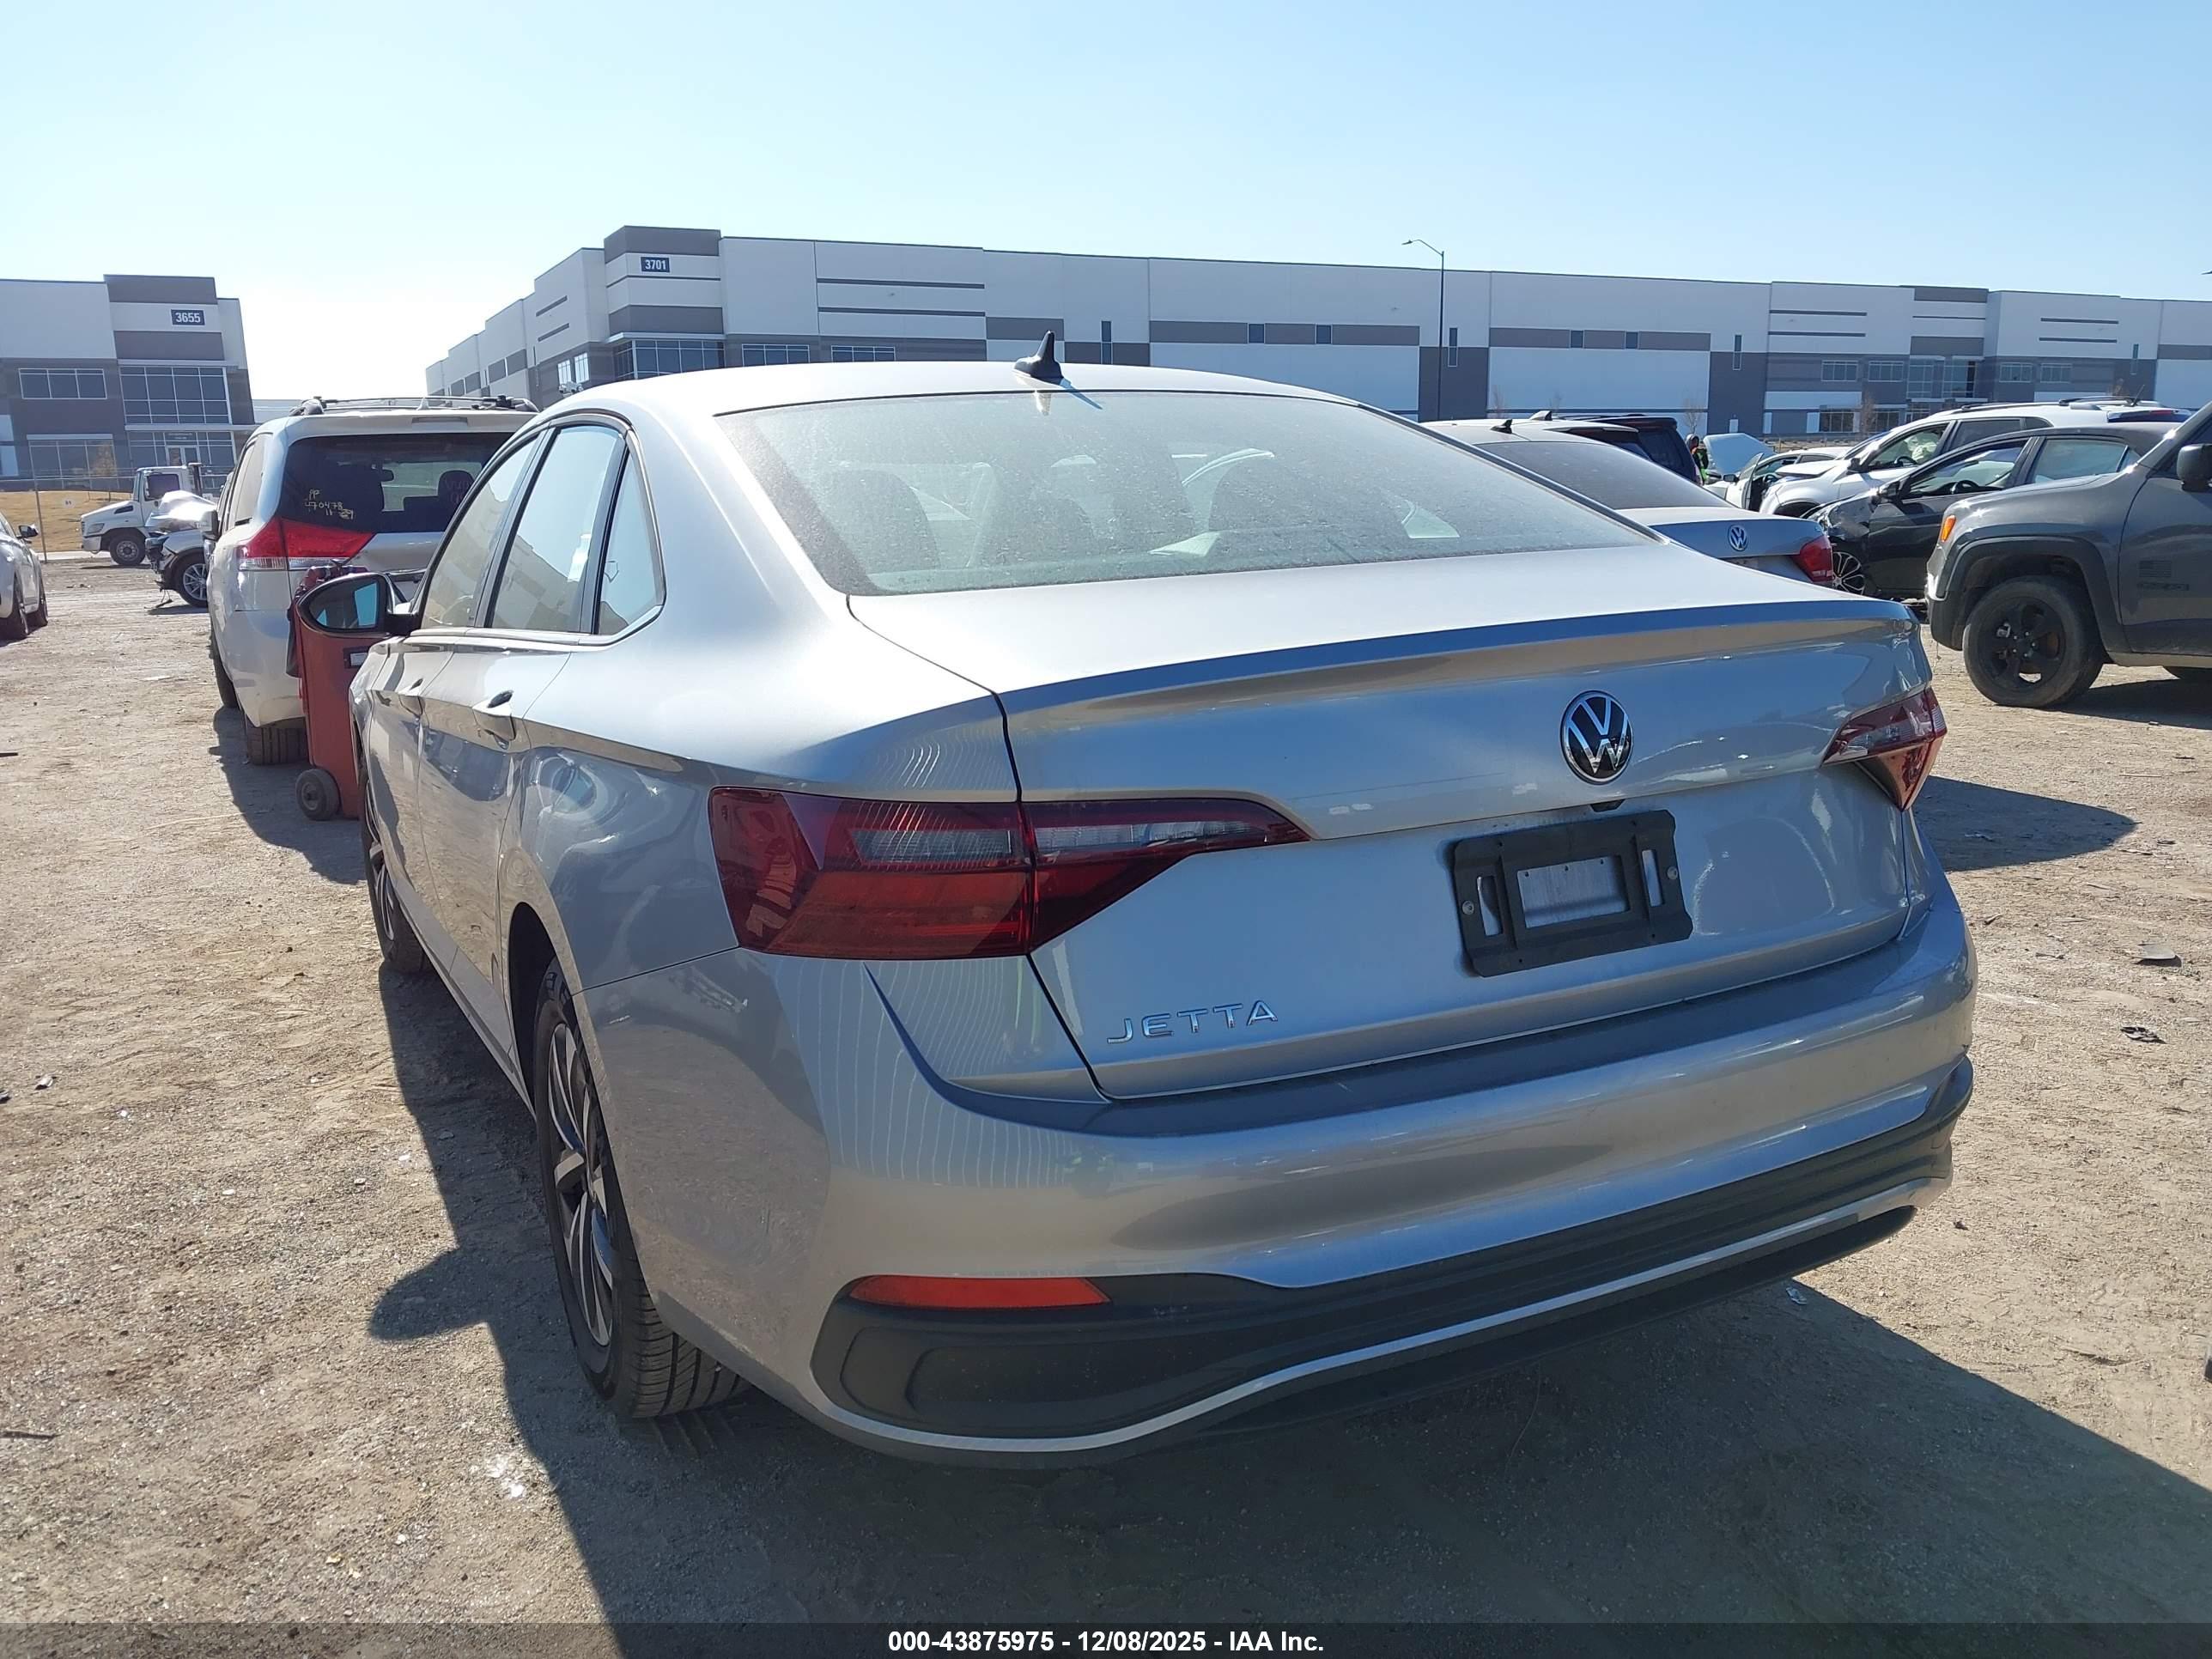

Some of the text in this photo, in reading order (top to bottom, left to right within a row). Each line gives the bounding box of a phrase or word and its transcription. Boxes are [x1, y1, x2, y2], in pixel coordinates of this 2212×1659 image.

[645, 259, 666, 270] 3701
[175, 312, 201, 323] 3655
[1564, 693, 1632, 779] VW
[1107, 1000, 1278, 1044] JETTA
